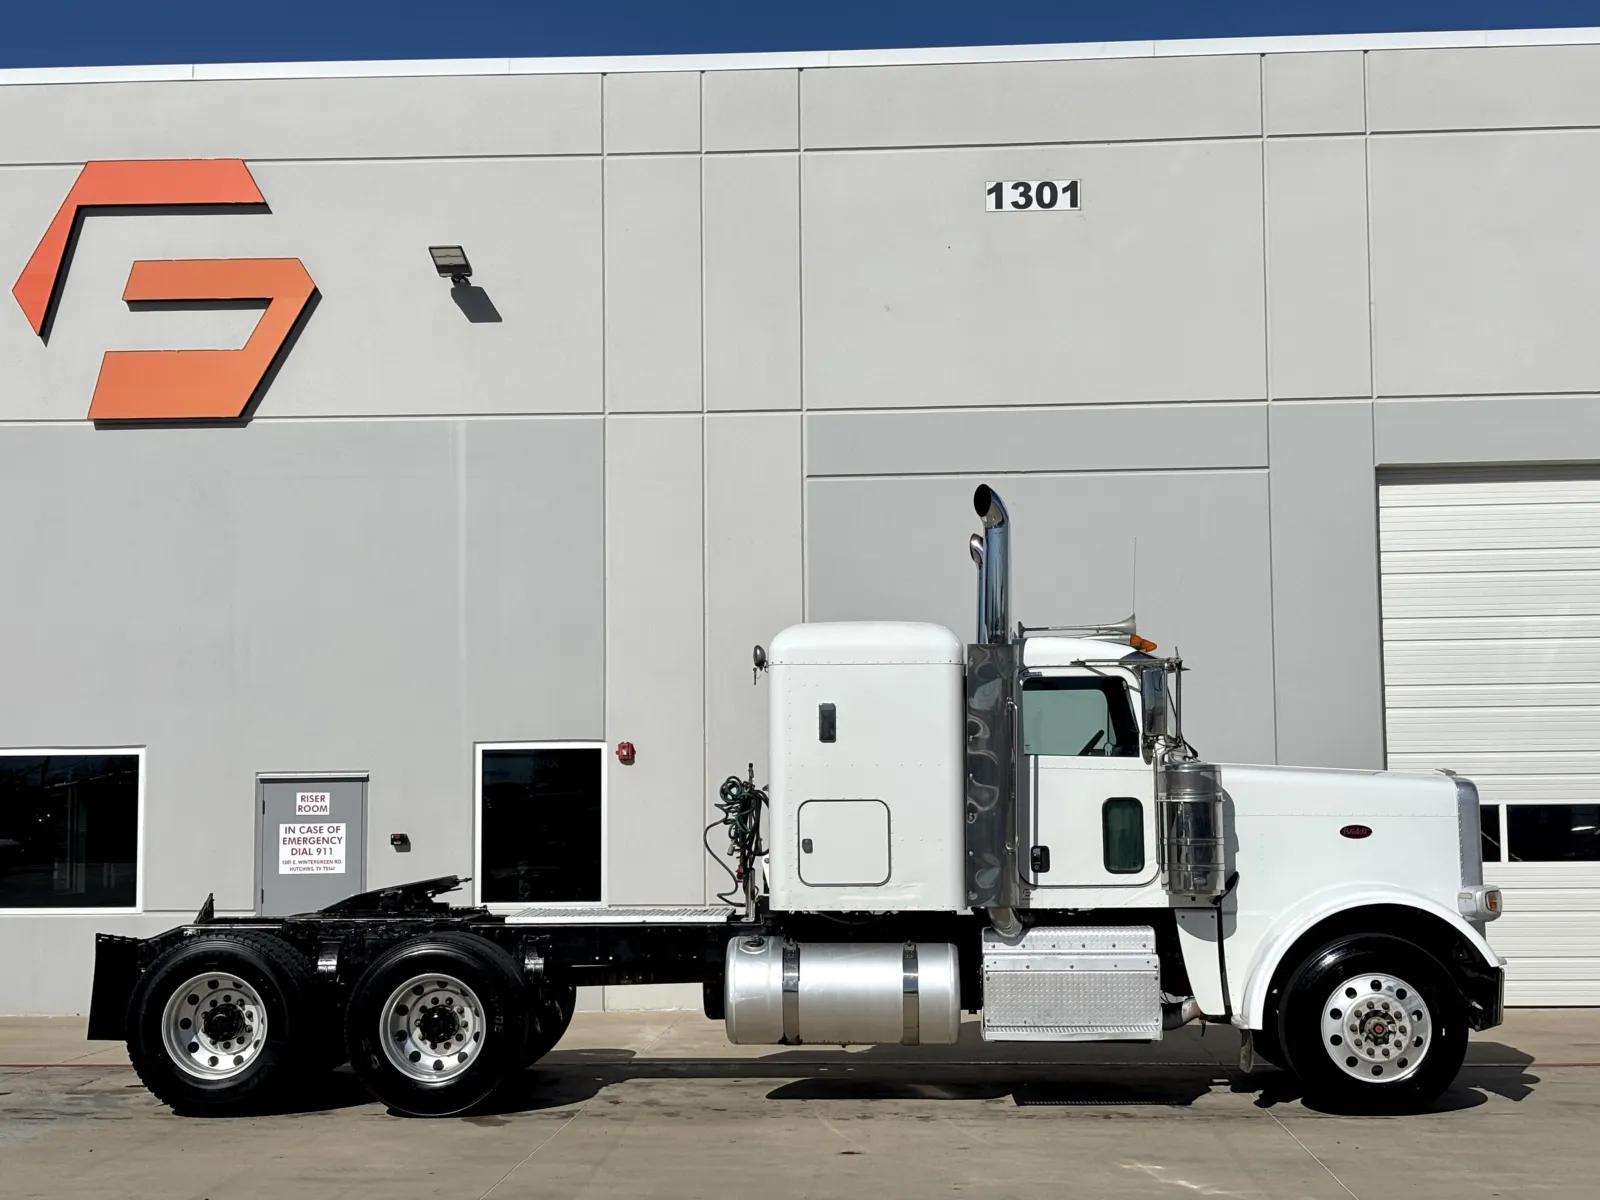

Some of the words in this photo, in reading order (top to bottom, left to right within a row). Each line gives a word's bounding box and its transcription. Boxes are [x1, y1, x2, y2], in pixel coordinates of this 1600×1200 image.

[987, 180, 1078, 210] 1301
[300, 795, 326, 803] RISER
[298, 805, 328, 813] ROOM
[285, 826, 296, 834] IN
[299, 825, 324, 834] CASE
[327, 825, 341, 834] OF
[282, 836, 343, 845] EMERGENCY
[290, 847, 313, 856] DIAL
[316, 847, 333, 856] 911
